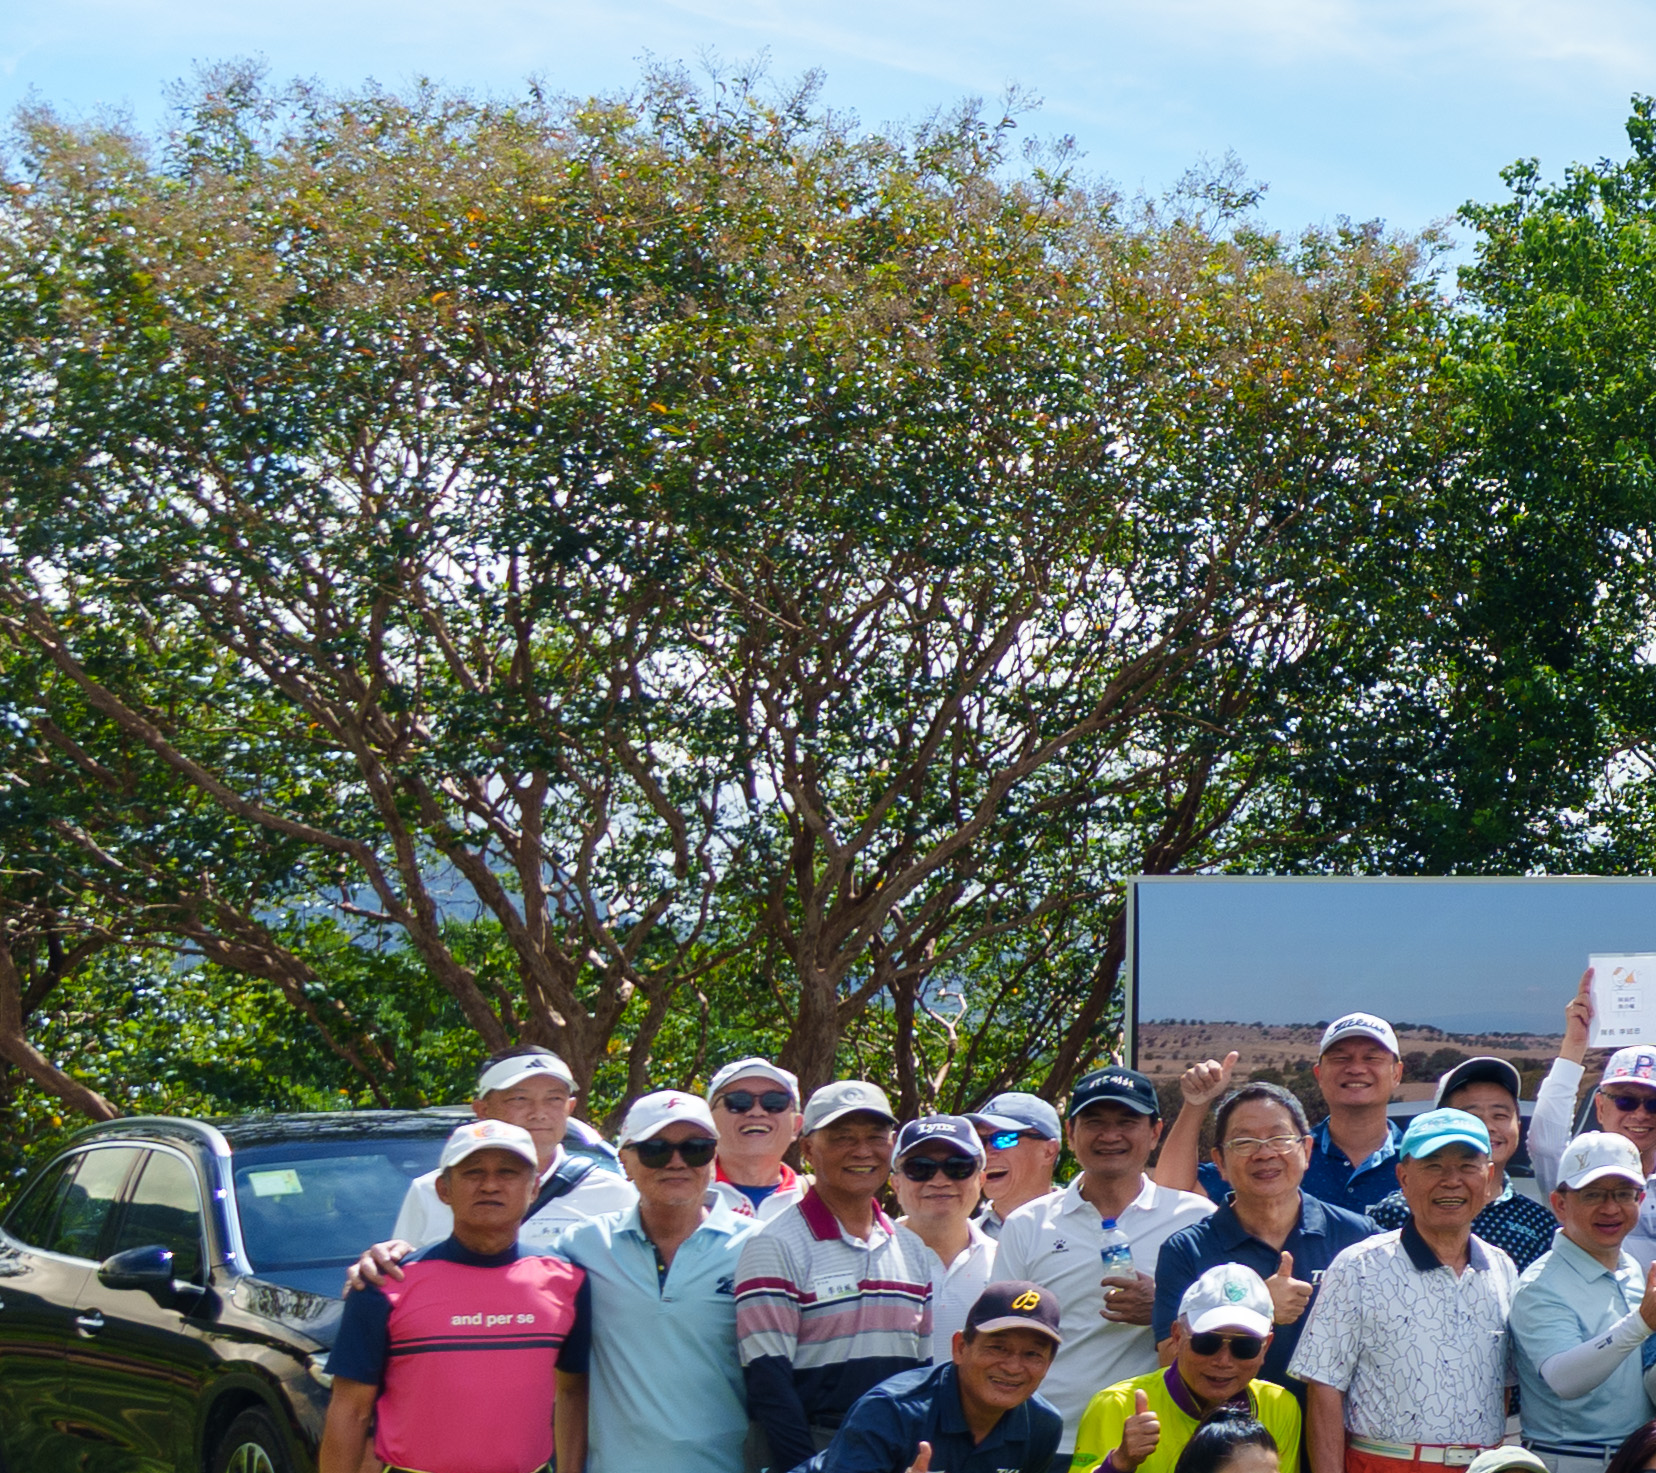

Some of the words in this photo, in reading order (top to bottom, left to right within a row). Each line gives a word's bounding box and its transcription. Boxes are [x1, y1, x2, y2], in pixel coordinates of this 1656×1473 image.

[1633, 1054, 1655, 1074] P
[917, 1122, 957, 1135] Lynx
[1011, 1289, 1041, 1310] B
[451, 1312, 483, 1326] and
[486, 1313, 513, 1328] per
[517, 1313, 535, 1324] se
